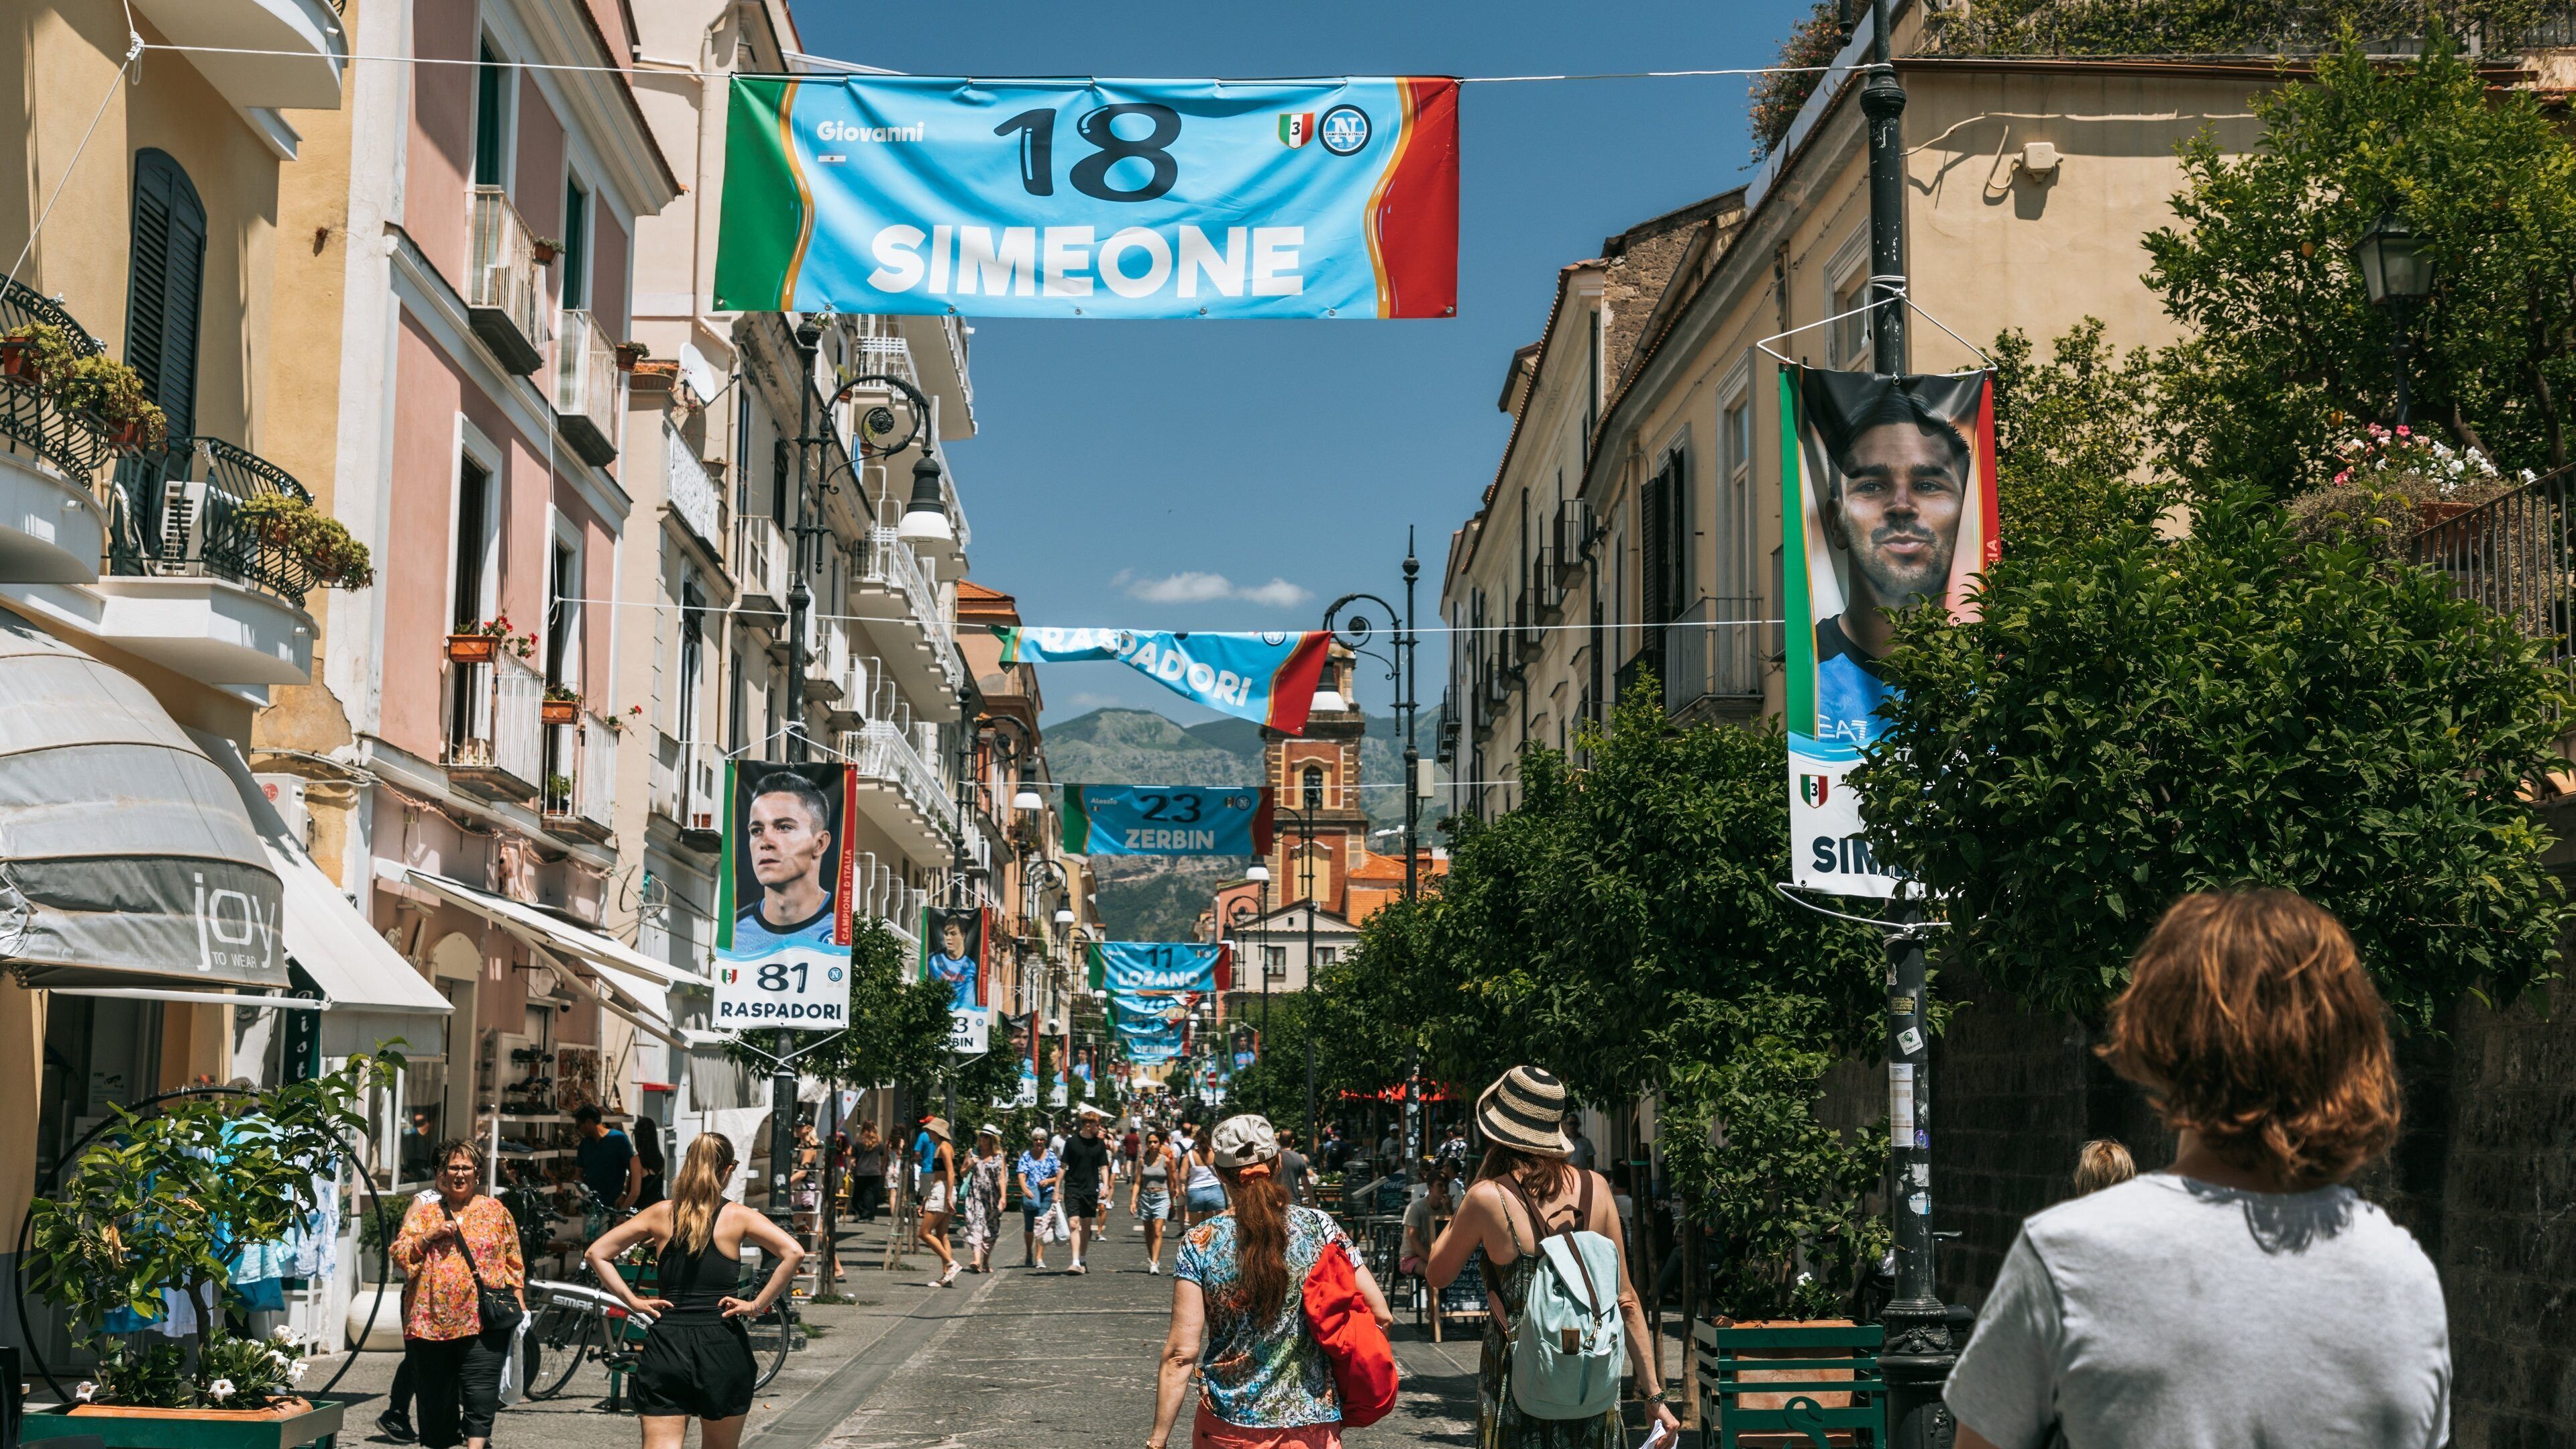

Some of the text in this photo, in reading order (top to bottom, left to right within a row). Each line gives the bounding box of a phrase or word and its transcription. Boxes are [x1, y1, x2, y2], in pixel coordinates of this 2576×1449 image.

[816, 120, 924, 143] Giovanni
[1291, 121, 1301, 136] 3
[993, 103, 1183, 203] 18
[865, 224, 1305, 298] SIMEONE
[1811, 783, 1819, 796] 3
[1090, 798, 1118, 806] Alessio
[1140, 794, 1201, 823] 23
[1125, 828, 1215, 849] ZERBIN
[841, 849, 853, 941] CAMPIONE D'ITALIA
[194, 872, 276, 971] joy
[211, 951, 257, 969] TO WEAR
[1145, 948, 1173, 968] 11
[757, 962, 808, 994] 81
[1118, 971, 1201, 987] LOZANO
[720, 1002, 841, 1020] RASPADORI
[953, 1016, 968, 1033] 3
